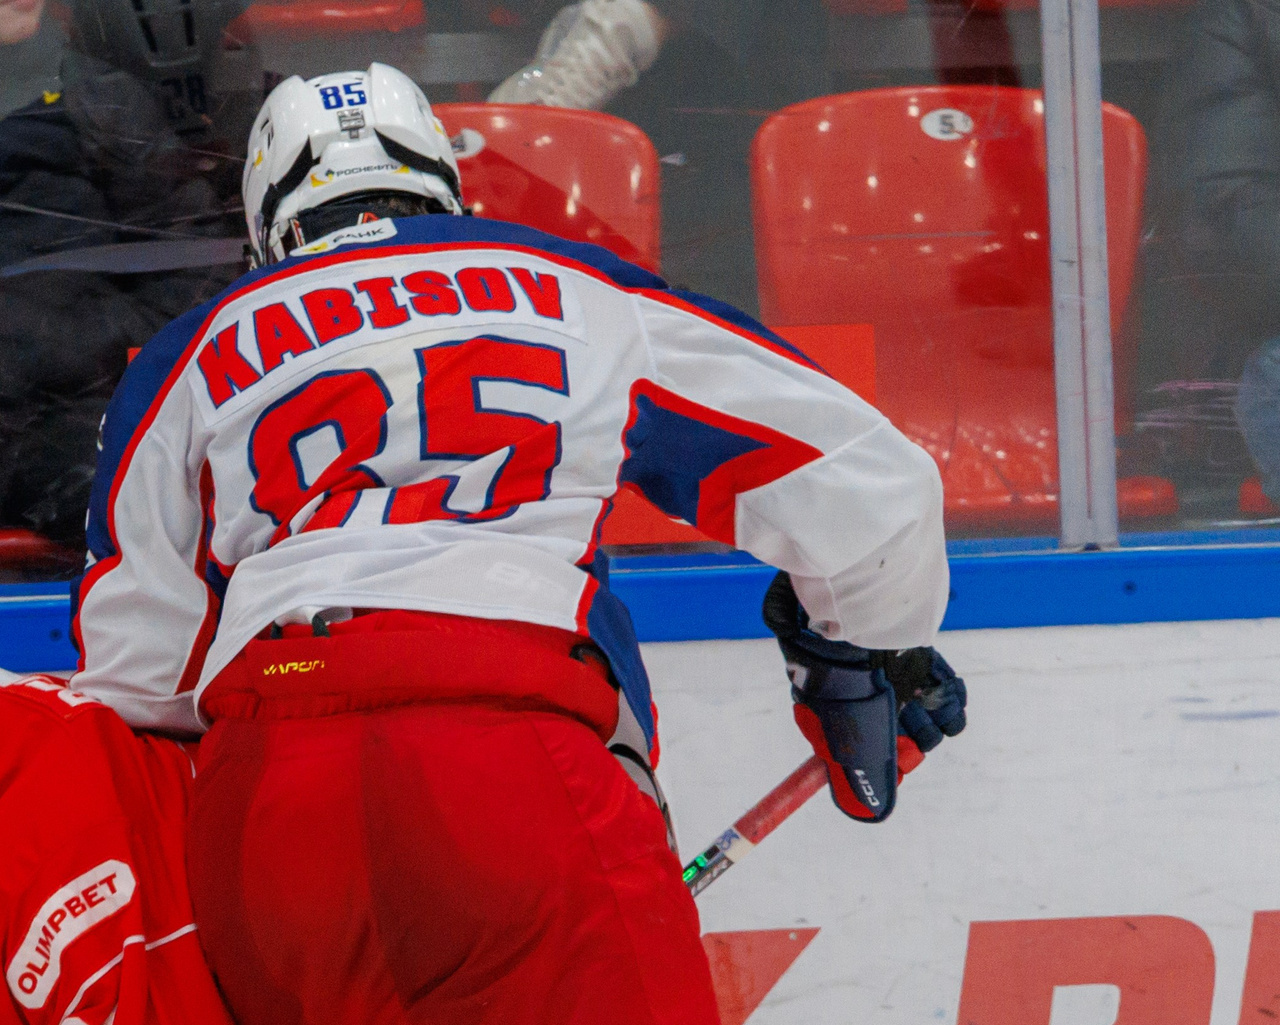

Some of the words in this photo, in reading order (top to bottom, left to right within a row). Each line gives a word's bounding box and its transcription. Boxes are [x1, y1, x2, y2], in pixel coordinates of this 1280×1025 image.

[319, 82, 367, 110] 85
[197, 267, 564, 410] KABISOV
[248, 334, 570, 551] 85
[18, 873, 118, 994] OLIMPBET
